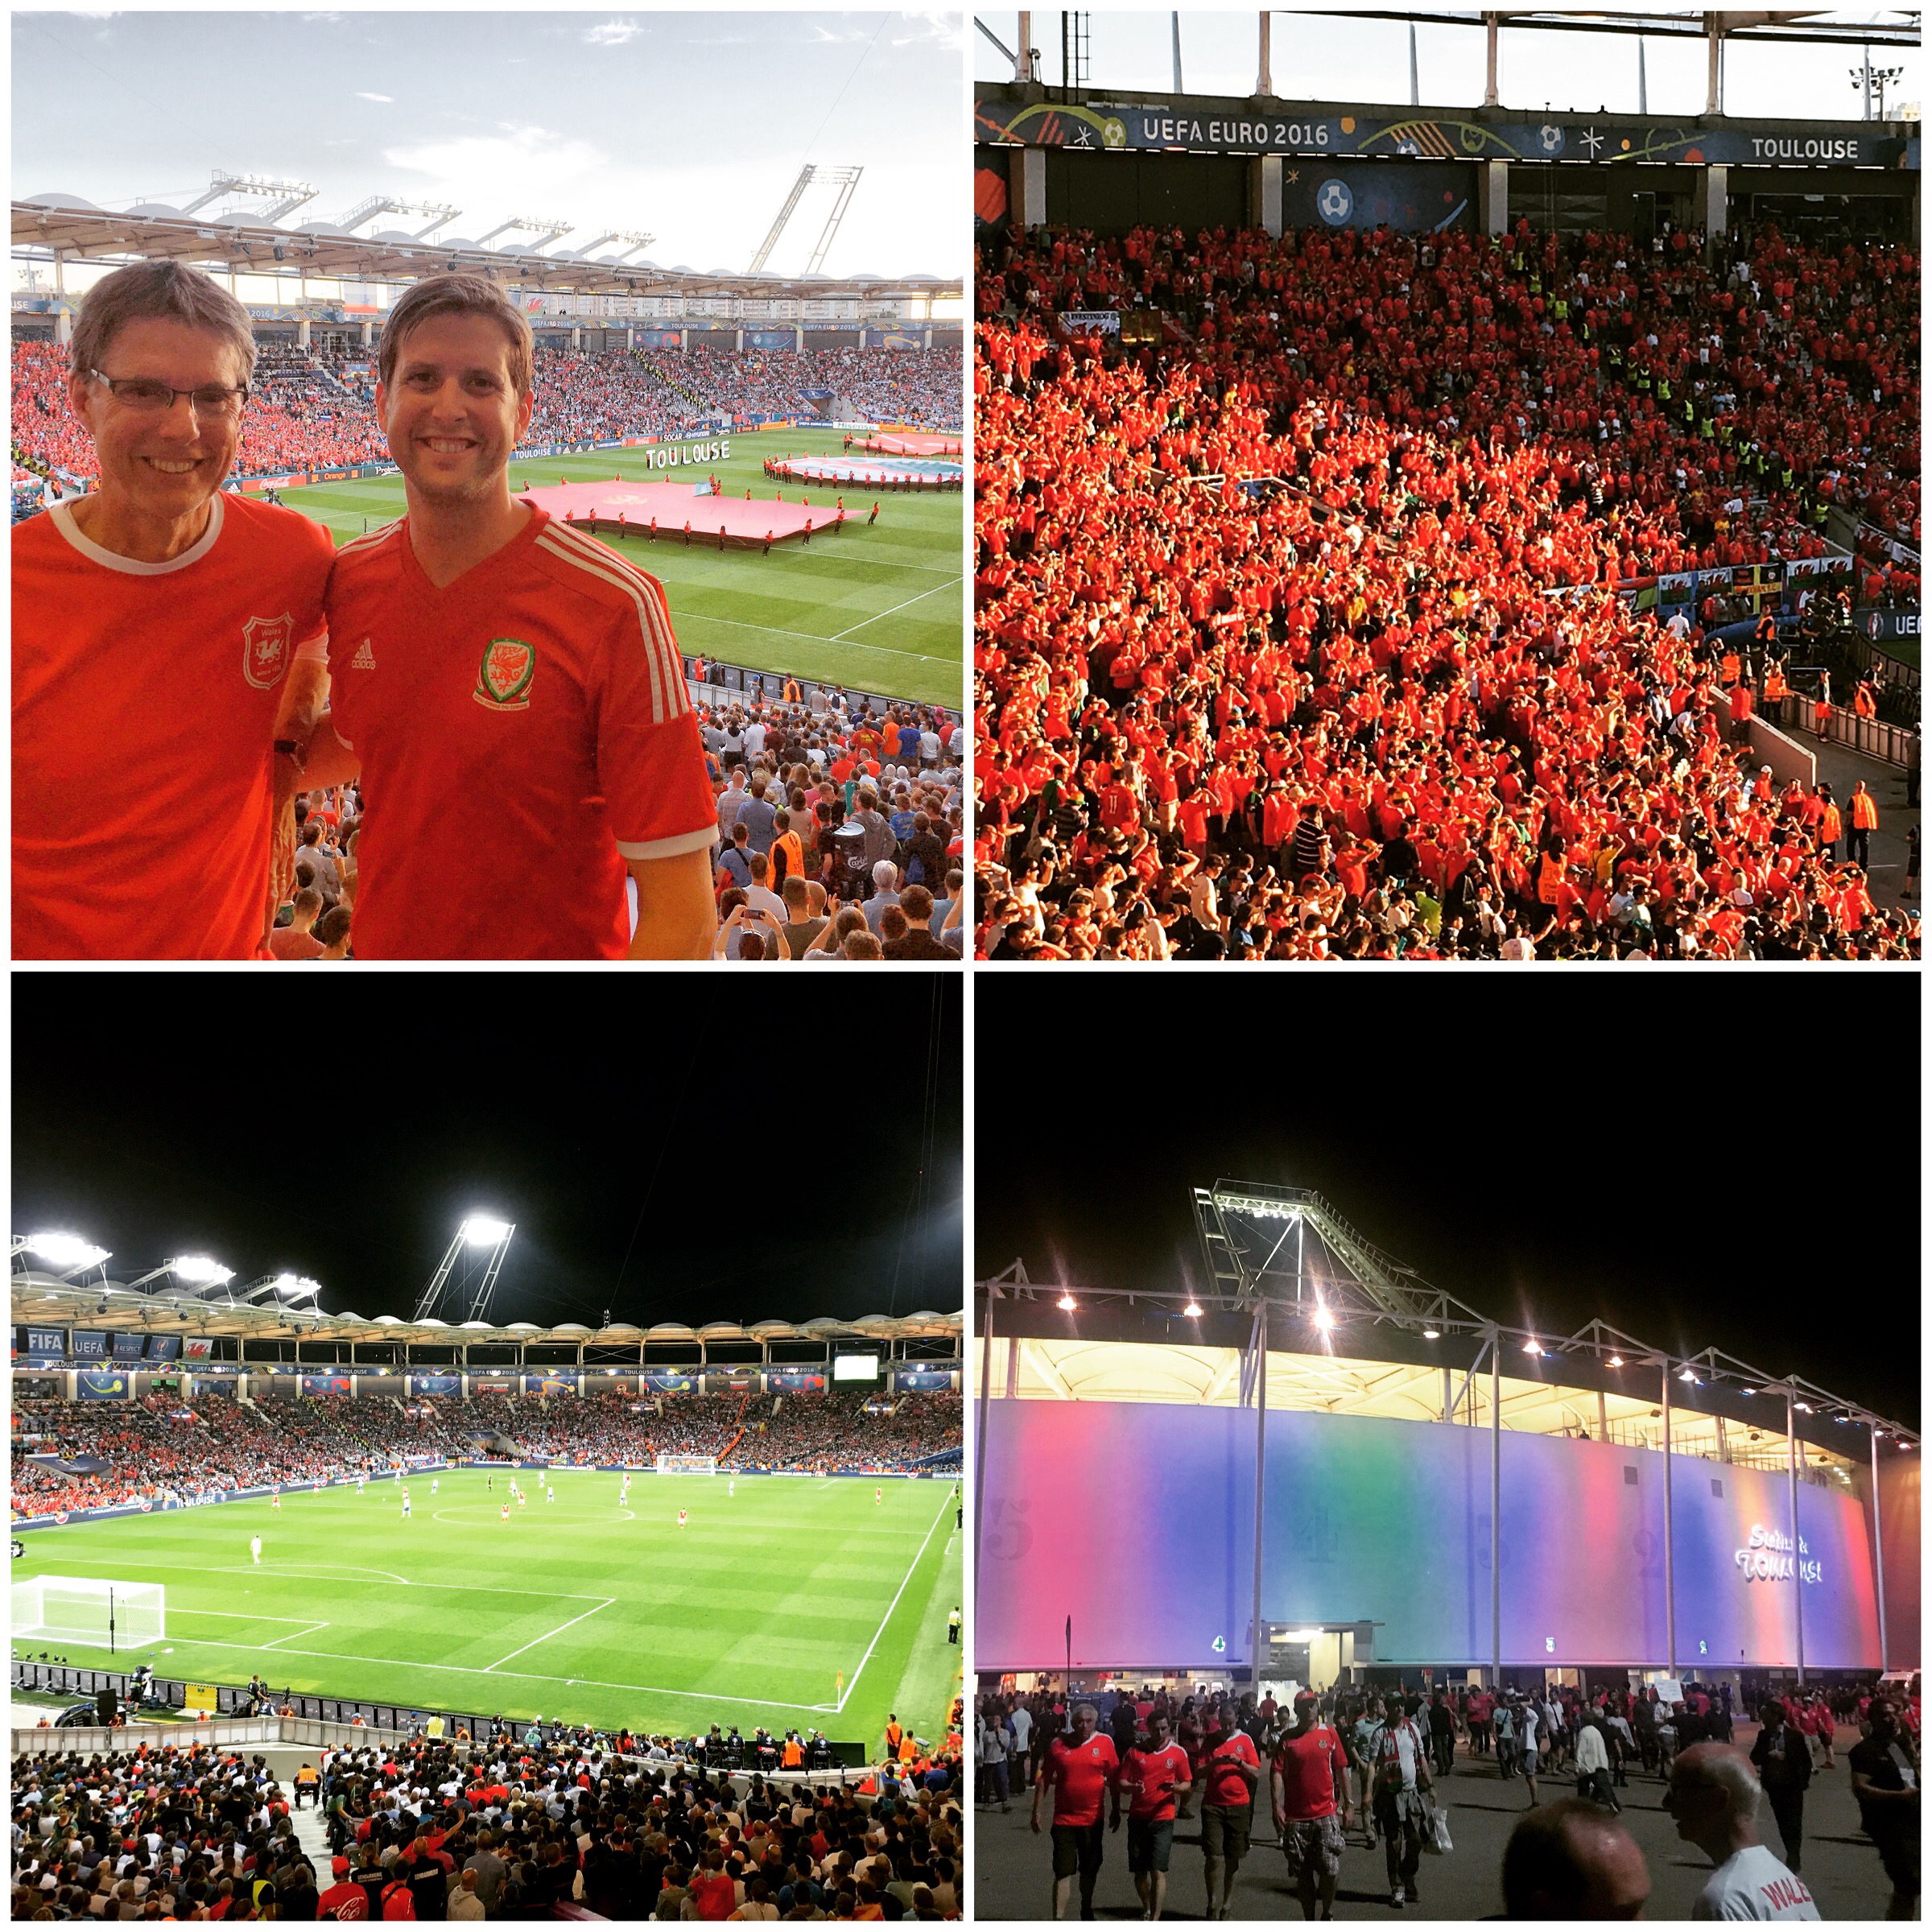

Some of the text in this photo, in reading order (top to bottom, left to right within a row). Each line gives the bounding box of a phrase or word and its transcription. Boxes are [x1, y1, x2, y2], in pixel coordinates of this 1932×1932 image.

[1144, 118, 1329, 147] UEFA EURO 2016
[1752, 138, 1858, 159] TOULOUSE
[838, 423, 875, 431] Hisense
[663, 433, 683, 442] SOCAR
[691, 431, 710, 439] HYUNDAI
[515, 448, 551, 460] TOULOUSE
[646, 440, 731, 470] TOULOUSE
[324, 472, 346, 480] Orange
[352, 658, 376, 670] adidas
[29, 1333, 63, 1350] FIFA
[75, 1342, 104, 1353] UEFA
[44, 1360, 78, 1368] TOULOUSE
[1212, 1635, 1226, 1653] 4
